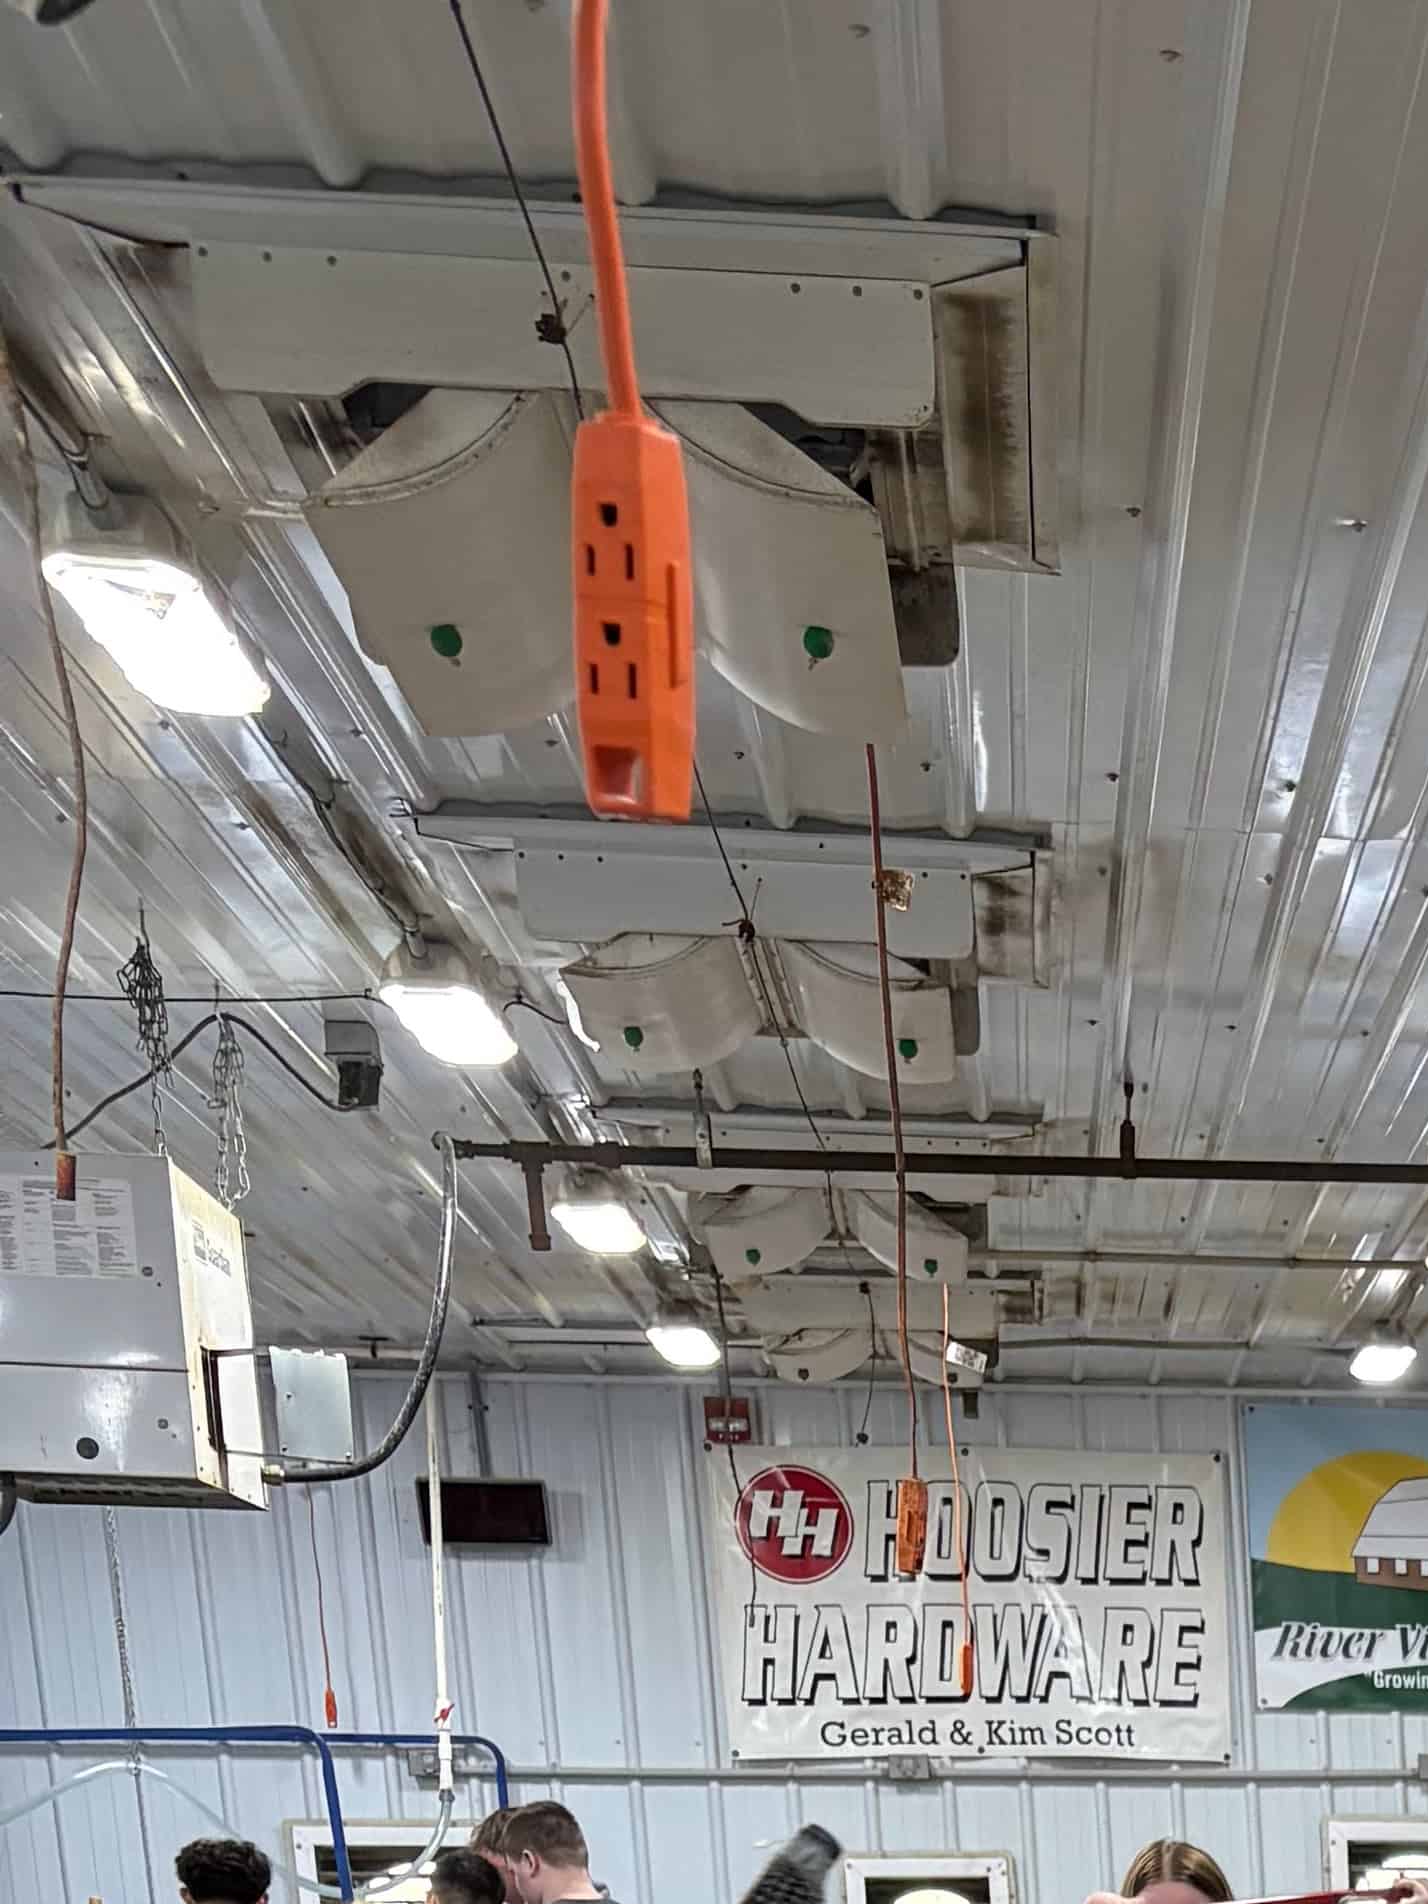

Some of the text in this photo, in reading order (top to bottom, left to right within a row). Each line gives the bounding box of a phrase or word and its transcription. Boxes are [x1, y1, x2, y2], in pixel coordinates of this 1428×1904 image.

[864, 1479, 1205, 1586] HOOSIER
[740, 1602, 1206, 1707] HARDWARE
[1271, 1621, 1385, 1662] River
[820, 1719, 1136, 1748] Gerald & Kim Scott
